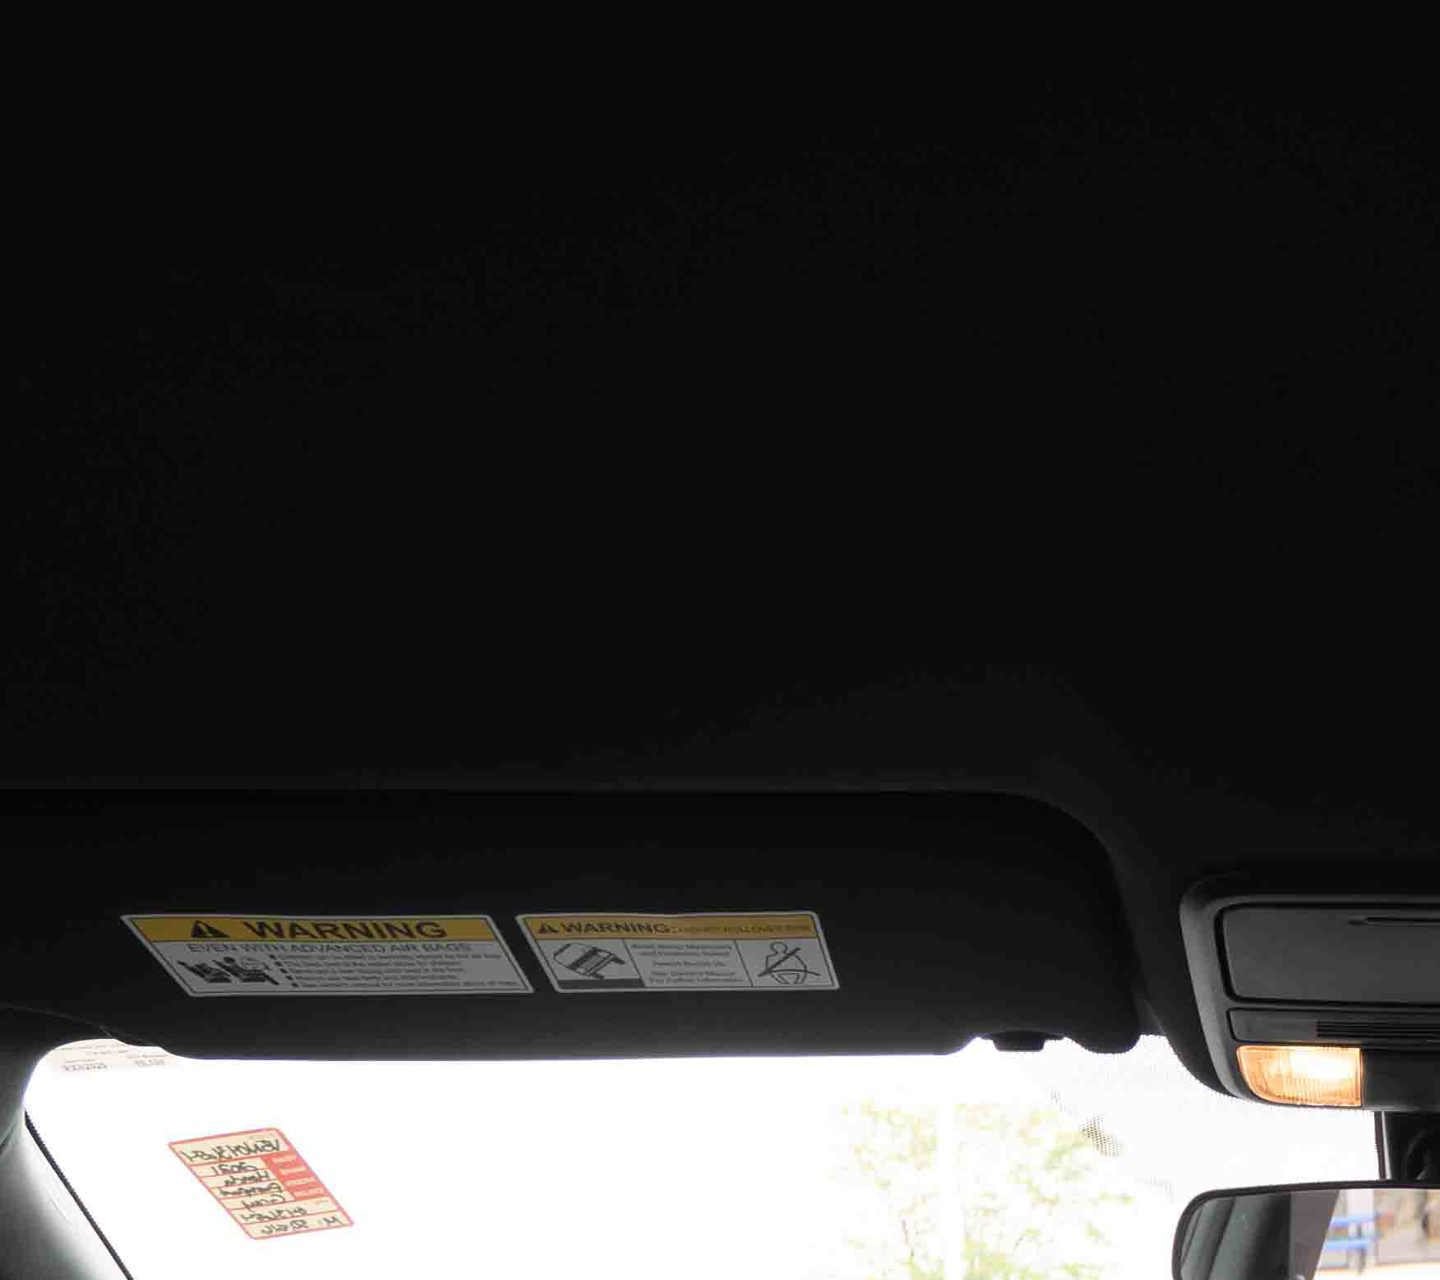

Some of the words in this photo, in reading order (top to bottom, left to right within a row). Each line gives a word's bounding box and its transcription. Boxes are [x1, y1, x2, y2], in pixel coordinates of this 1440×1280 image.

[243, 920, 448, 940] WARNING
[187, 942, 238, 954] EVEN
[242, 942, 286, 954] WITH
[289, 942, 386, 954] ADVANCED
[389, 941, 418, 954] AIR
[421, 942, 472, 954] BAGS
